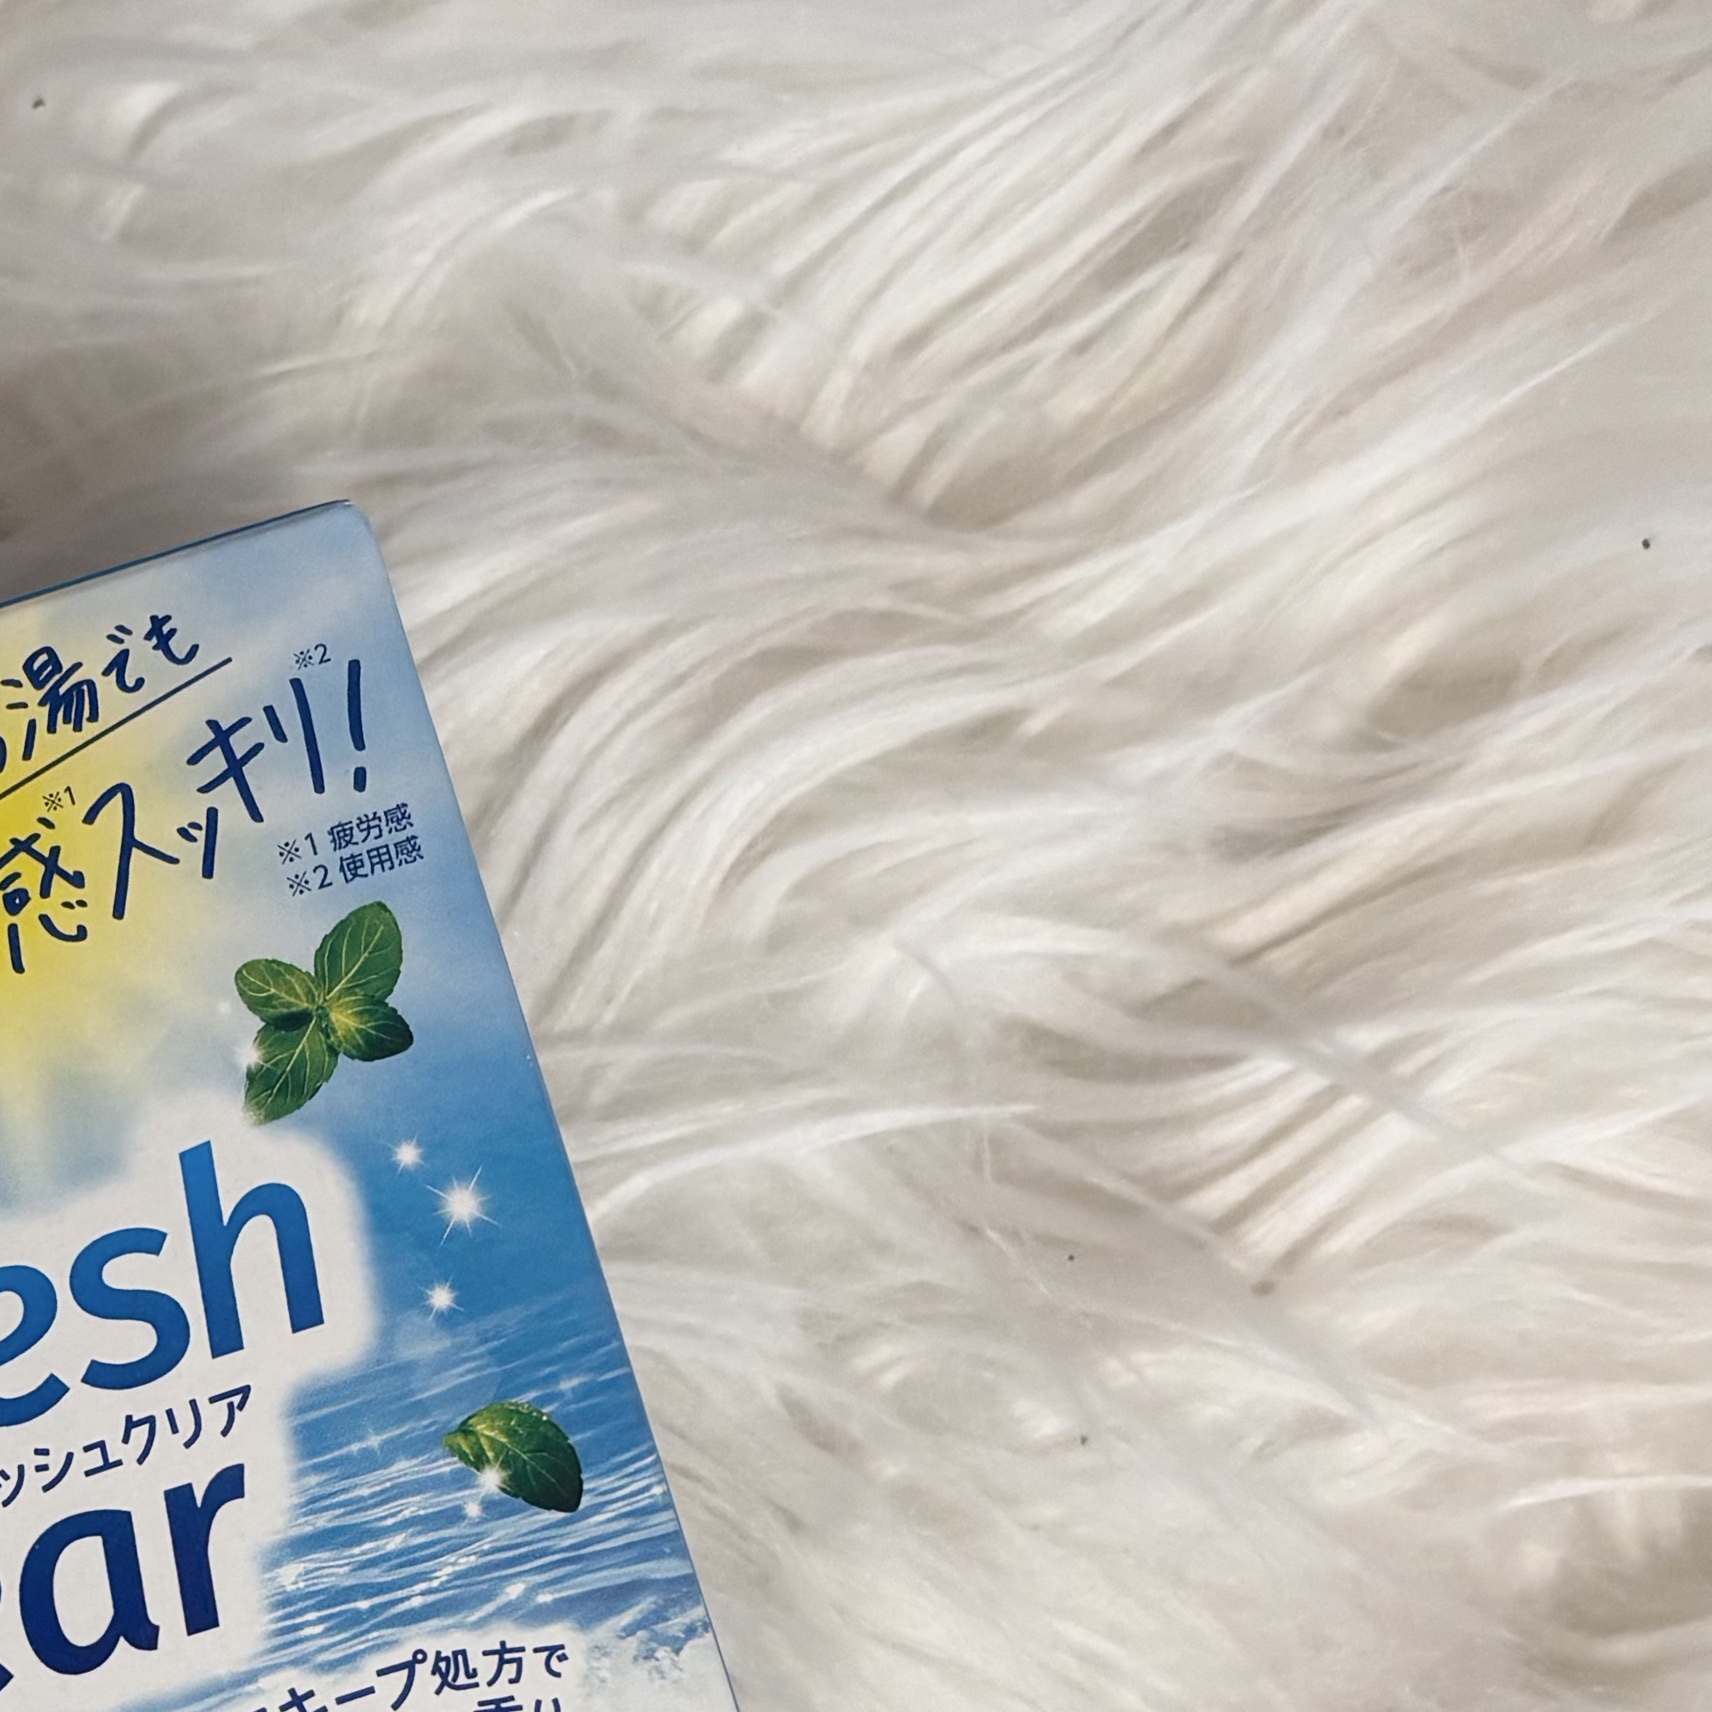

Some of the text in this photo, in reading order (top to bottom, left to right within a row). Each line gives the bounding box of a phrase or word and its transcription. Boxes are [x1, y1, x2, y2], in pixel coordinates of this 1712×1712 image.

[327, 803, 415, 851] 疲労感
[339, 835, 424, 884] 使用感
